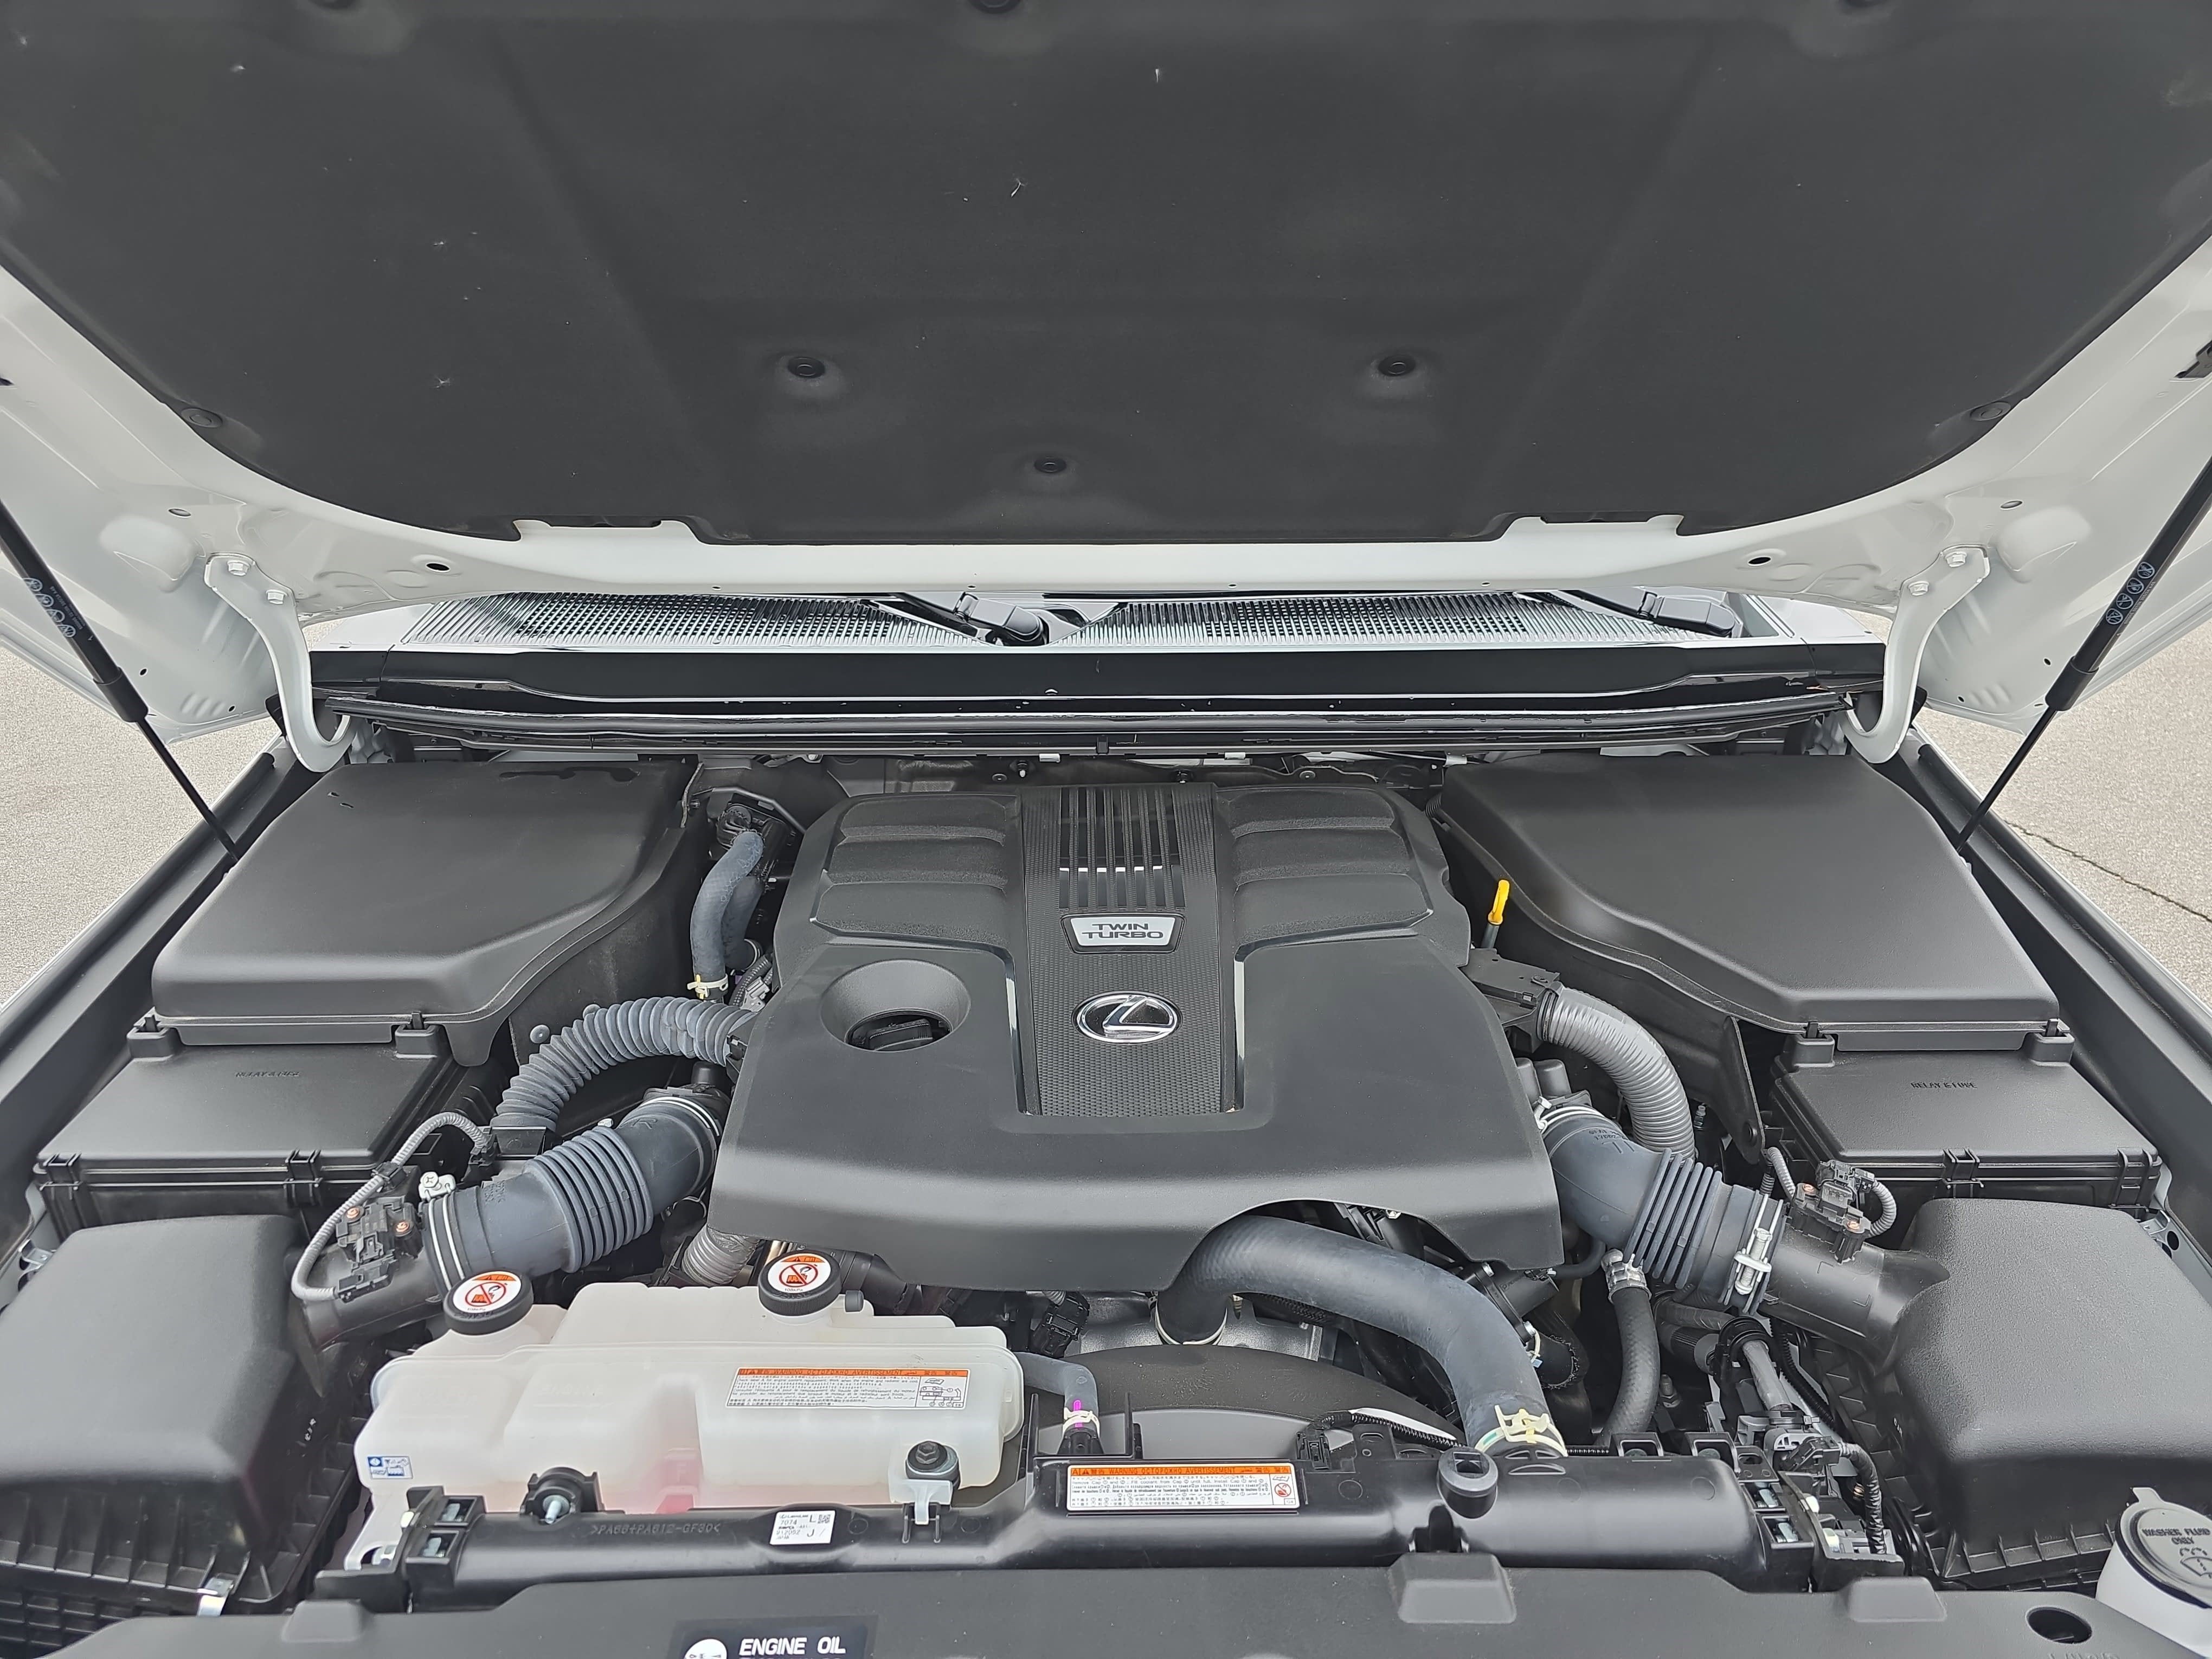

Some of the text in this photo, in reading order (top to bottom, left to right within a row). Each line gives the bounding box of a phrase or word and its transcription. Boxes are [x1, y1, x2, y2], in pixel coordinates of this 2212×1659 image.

[2142, 1528, 2182, 1536] WASHER
[2171, 1536, 2194, 1545] ONLY
[738, 1637, 846, 1655] ENGINE OIL
